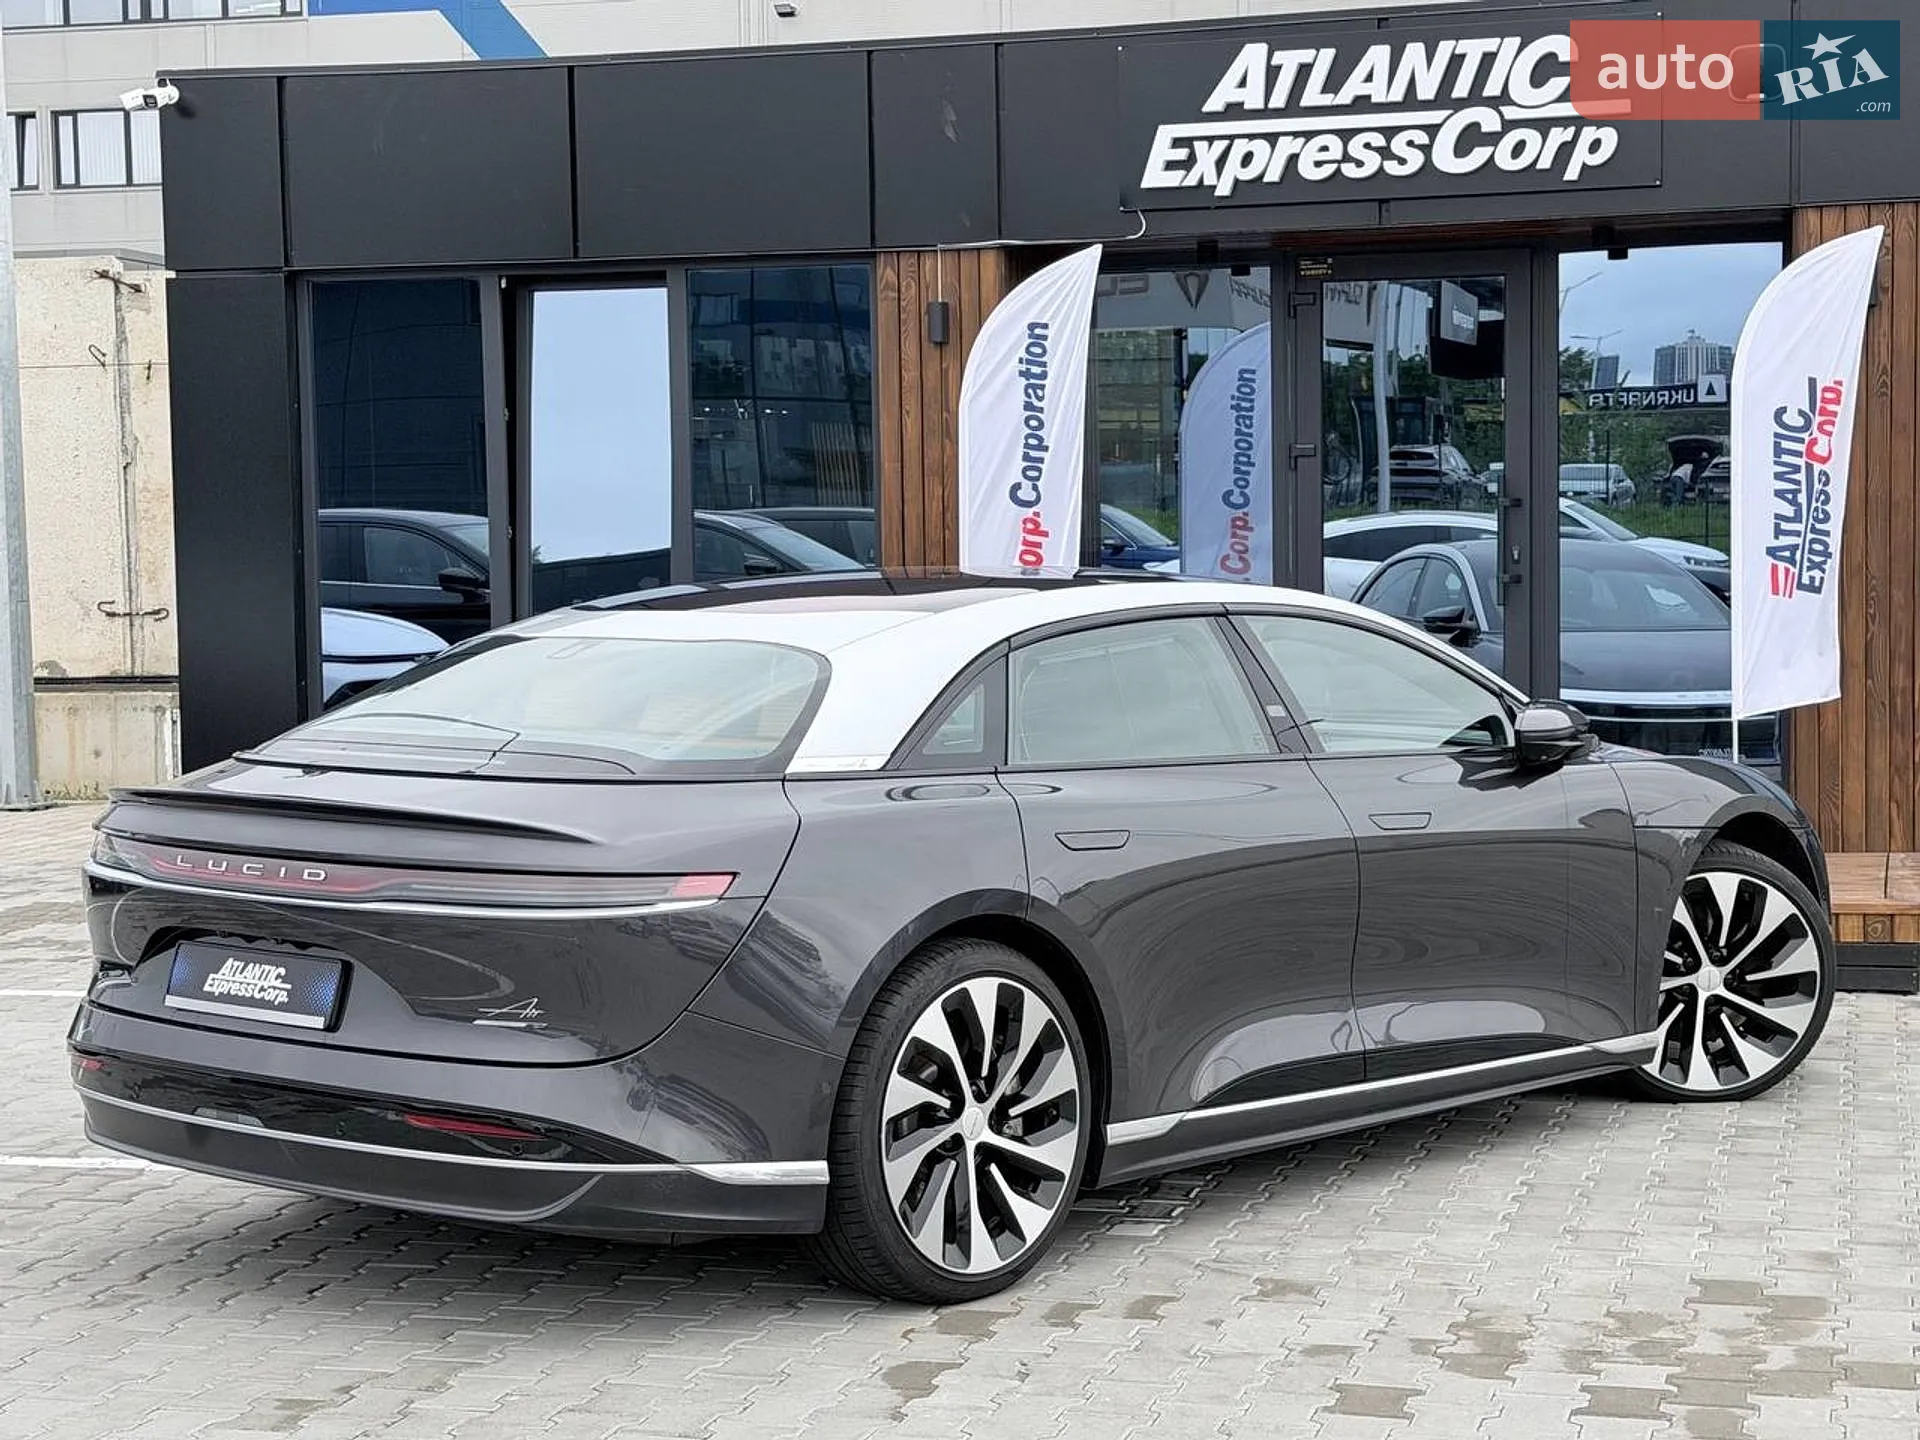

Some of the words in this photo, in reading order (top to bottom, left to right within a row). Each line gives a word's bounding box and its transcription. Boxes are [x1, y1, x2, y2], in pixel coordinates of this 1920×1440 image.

[1201, 34, 1579, 113] ATLANTIC
[1140, 107, 1620, 197] ExpressCorp
[1008, 321, 1050, 508] Corporation
[1221, 367, 1257, 511] Corporation
[1765, 405, 1812, 569] ATLANTIC
[176, 855, 327, 881] LUCID
[217, 957, 287, 984] ATLANTIC
